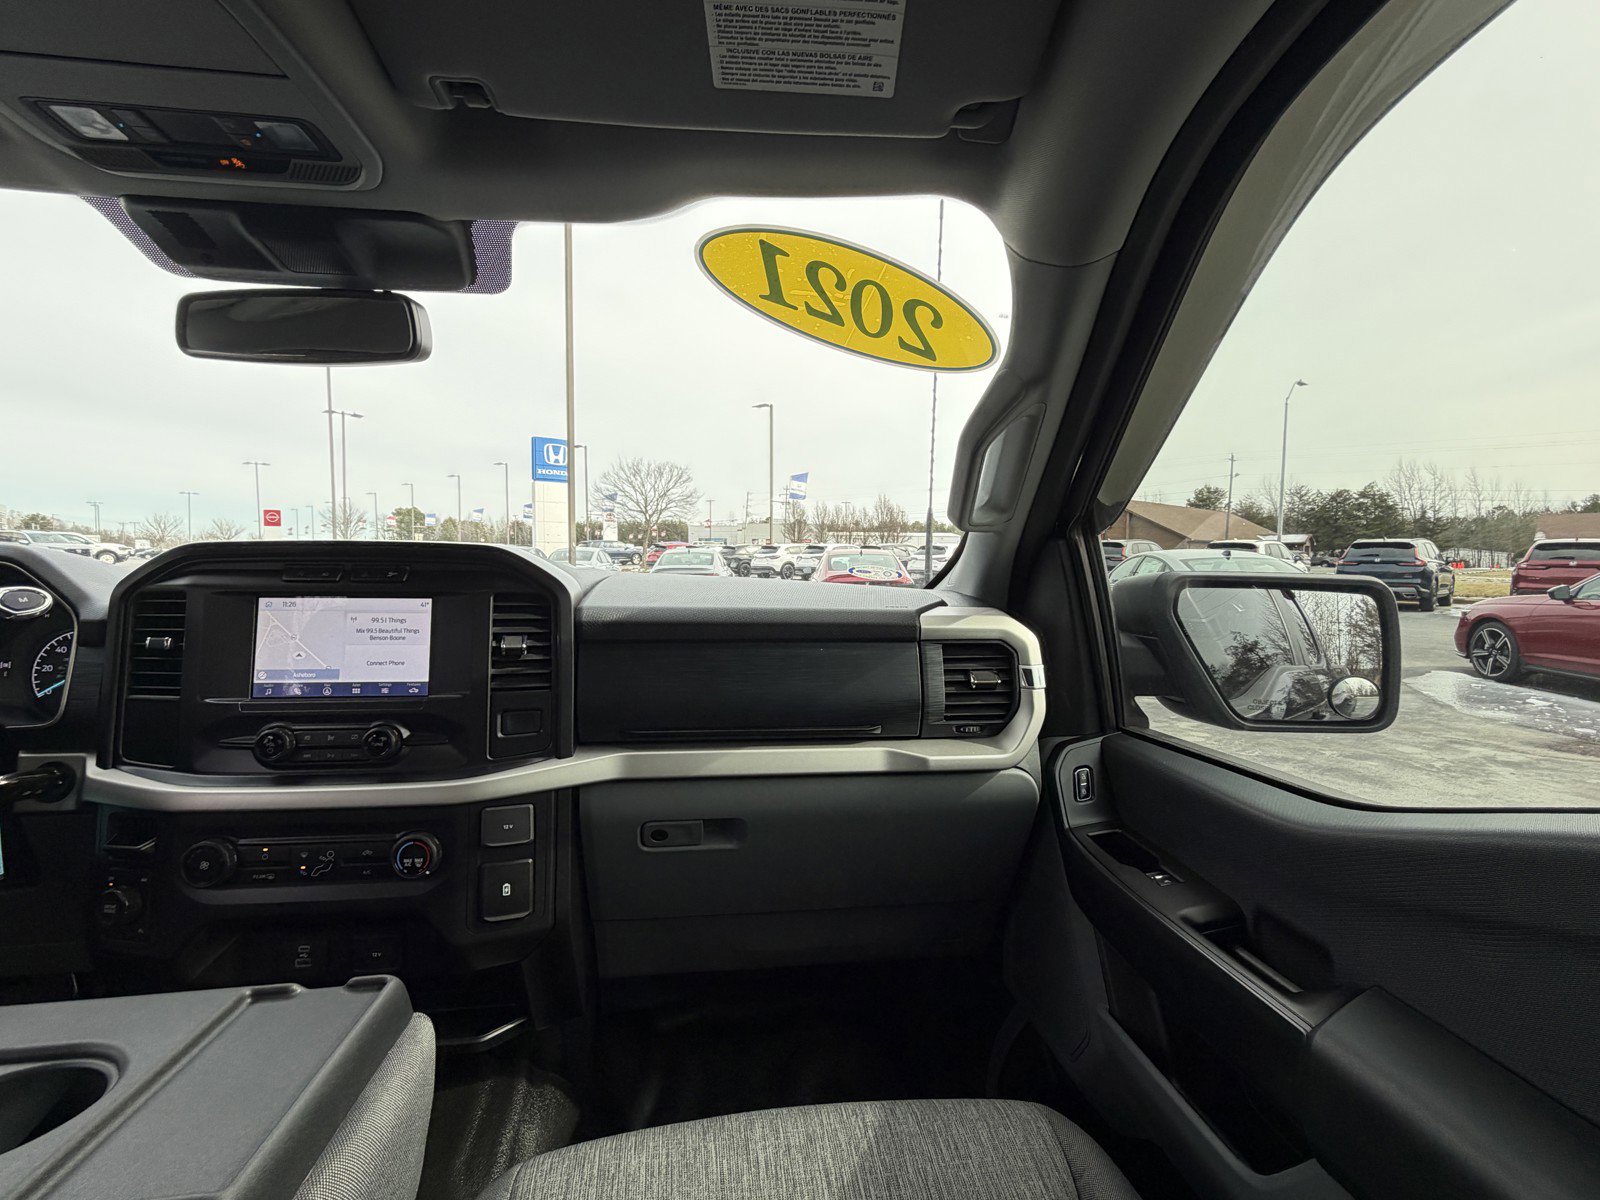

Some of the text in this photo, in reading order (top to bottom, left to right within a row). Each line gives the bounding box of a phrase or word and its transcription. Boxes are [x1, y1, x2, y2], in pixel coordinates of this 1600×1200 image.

[735, 5, 753, 13] AVEC
[790, 8, 837, 17] GONFLABLES
[839, 10, 897, 21] PERFECTIONNÉS
[791, 51, 818, 59] NUEVAS
[819, 52, 846, 60] BOLSAS
[847, 53, 857, 61] DE
[857, 54, 873, 62] AIRE
[388, 617, 407, 625] Things
